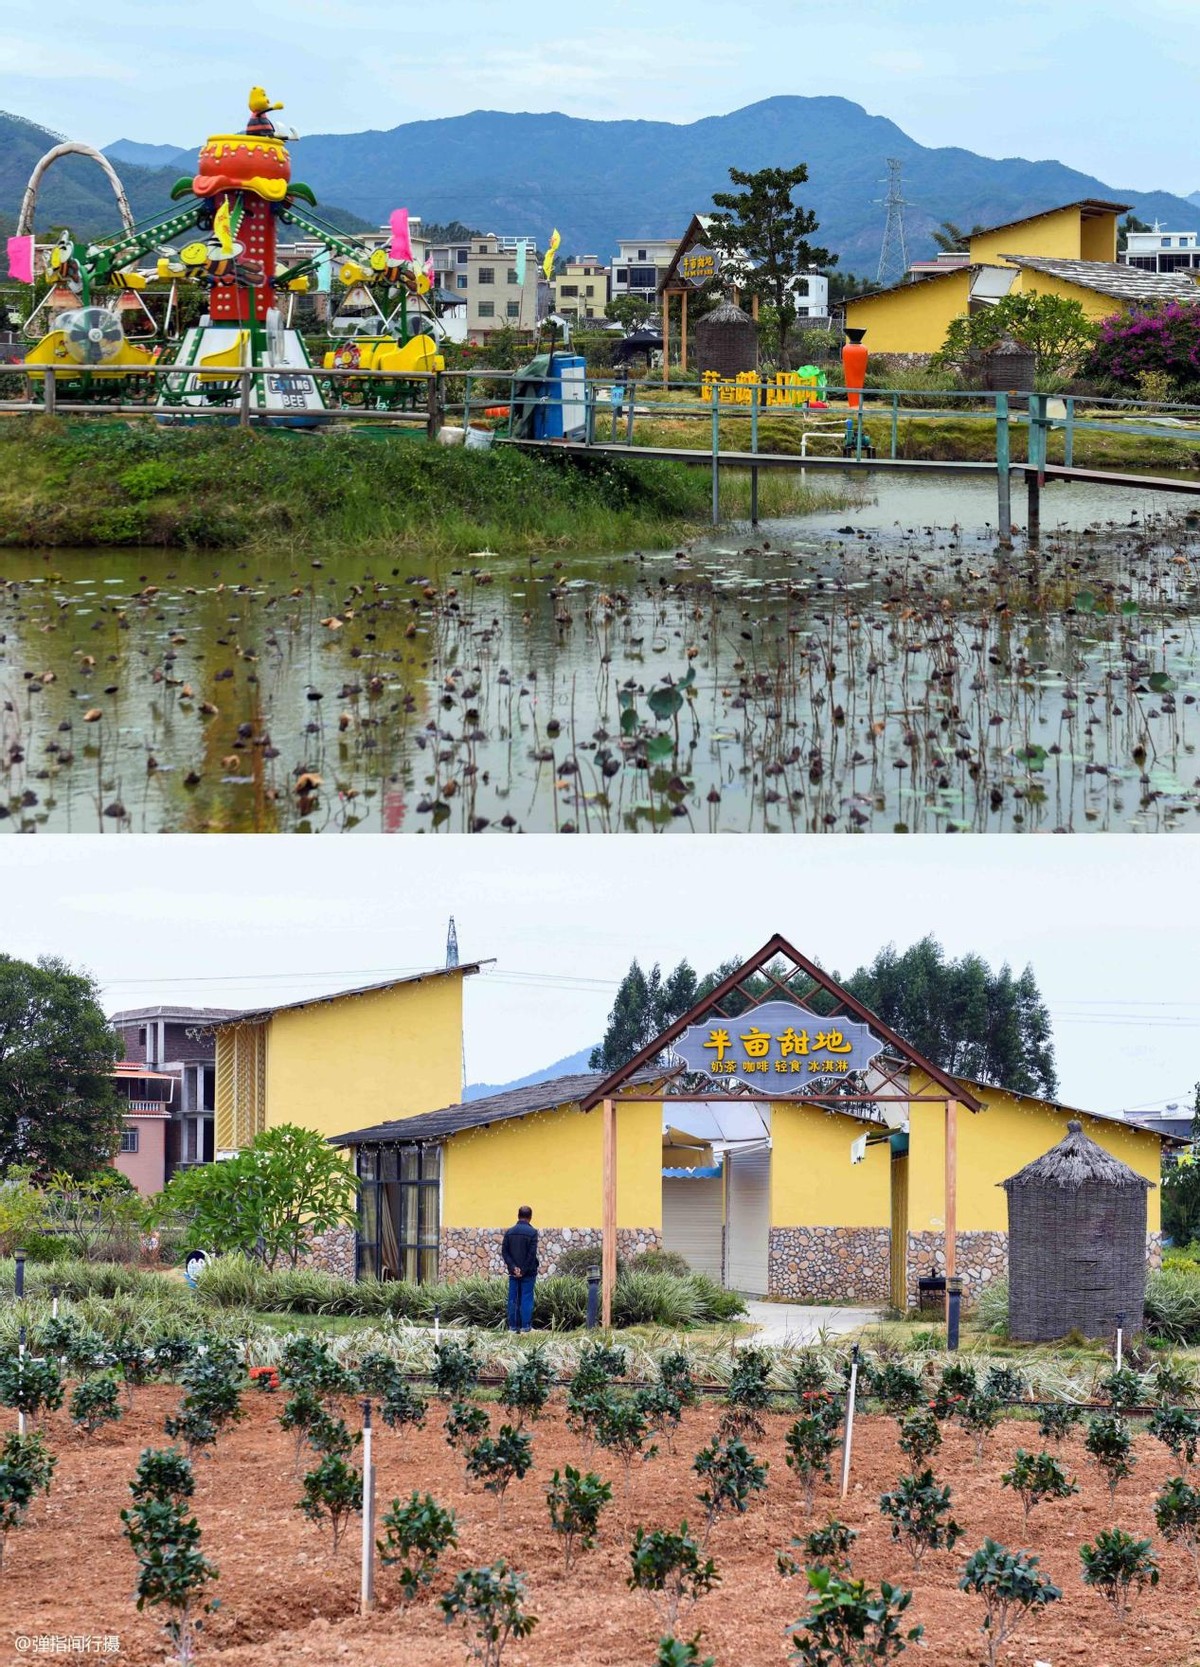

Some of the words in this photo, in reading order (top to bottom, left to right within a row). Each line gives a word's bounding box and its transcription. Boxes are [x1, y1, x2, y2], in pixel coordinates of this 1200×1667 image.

[271, 380, 310, 390] FLYING
[283, 394, 305, 407] BEE
[703, 1027, 852, 1060] 半亩甜地
[711, 1060, 737, 1073] 奶茶
[742, 1060, 769, 1073] 咖啡
[775, 1059, 802, 1073] 轻食
[808, 1060, 848, 1073] 冰淇淋
